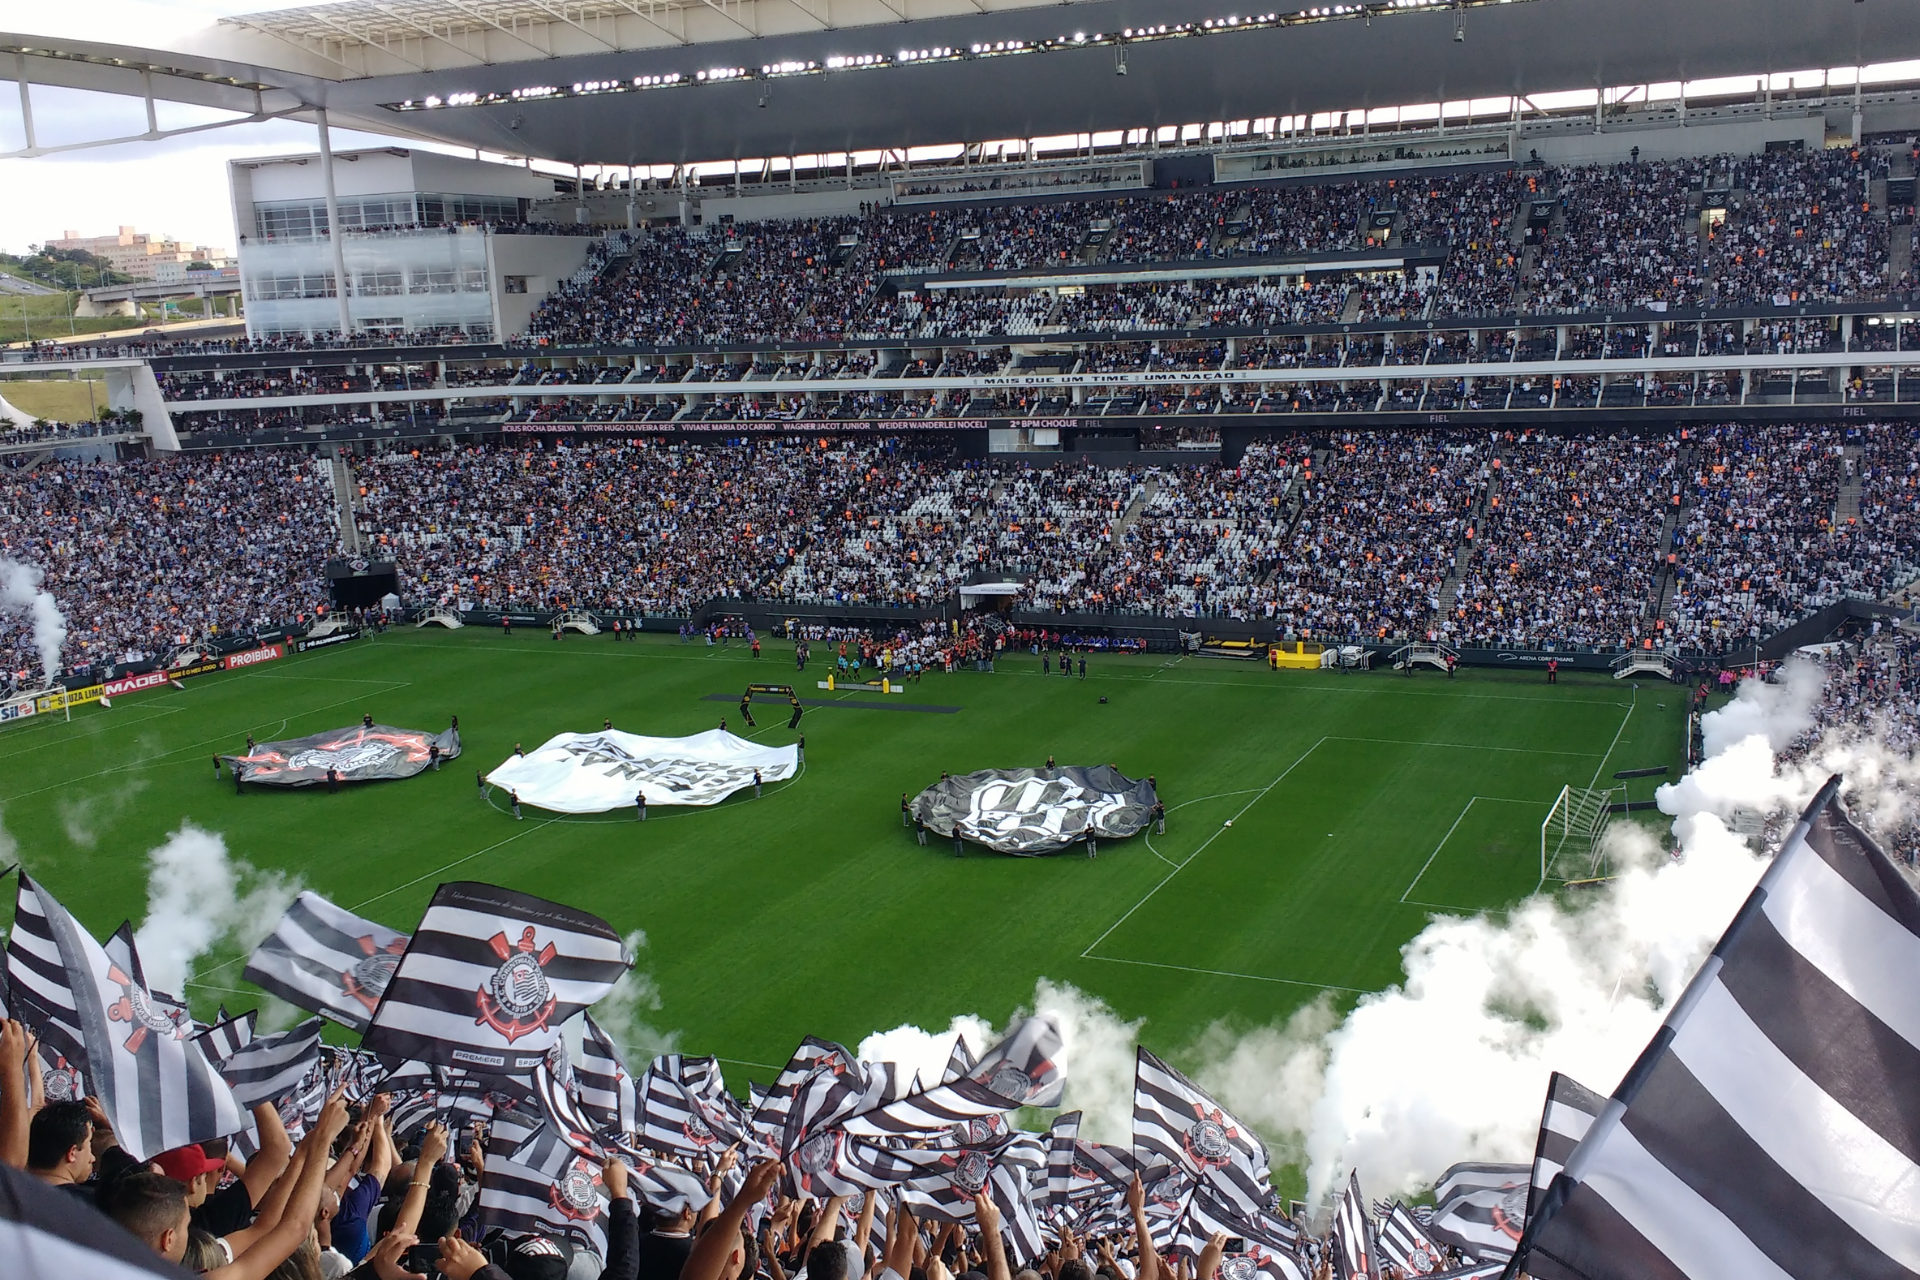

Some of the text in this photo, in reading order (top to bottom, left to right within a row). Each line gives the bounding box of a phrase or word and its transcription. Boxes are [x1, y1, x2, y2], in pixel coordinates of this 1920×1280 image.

[1843, 407, 1867, 416] FIEL
[1430, 414, 1450, 422] FIEL
[604, 424, 625, 432] HUGO
[841, 422, 871, 430] JUNIOR
[909, 421, 956, 429] WANDERLEI
[1022, 420, 1040, 428] BPM
[1041, 420, 1078, 428] CHOQUE
[84, 688, 104, 699] LIMA
[0, 706, 18, 720] Sil
[456, 1052, 502, 1064] PREMIERE
